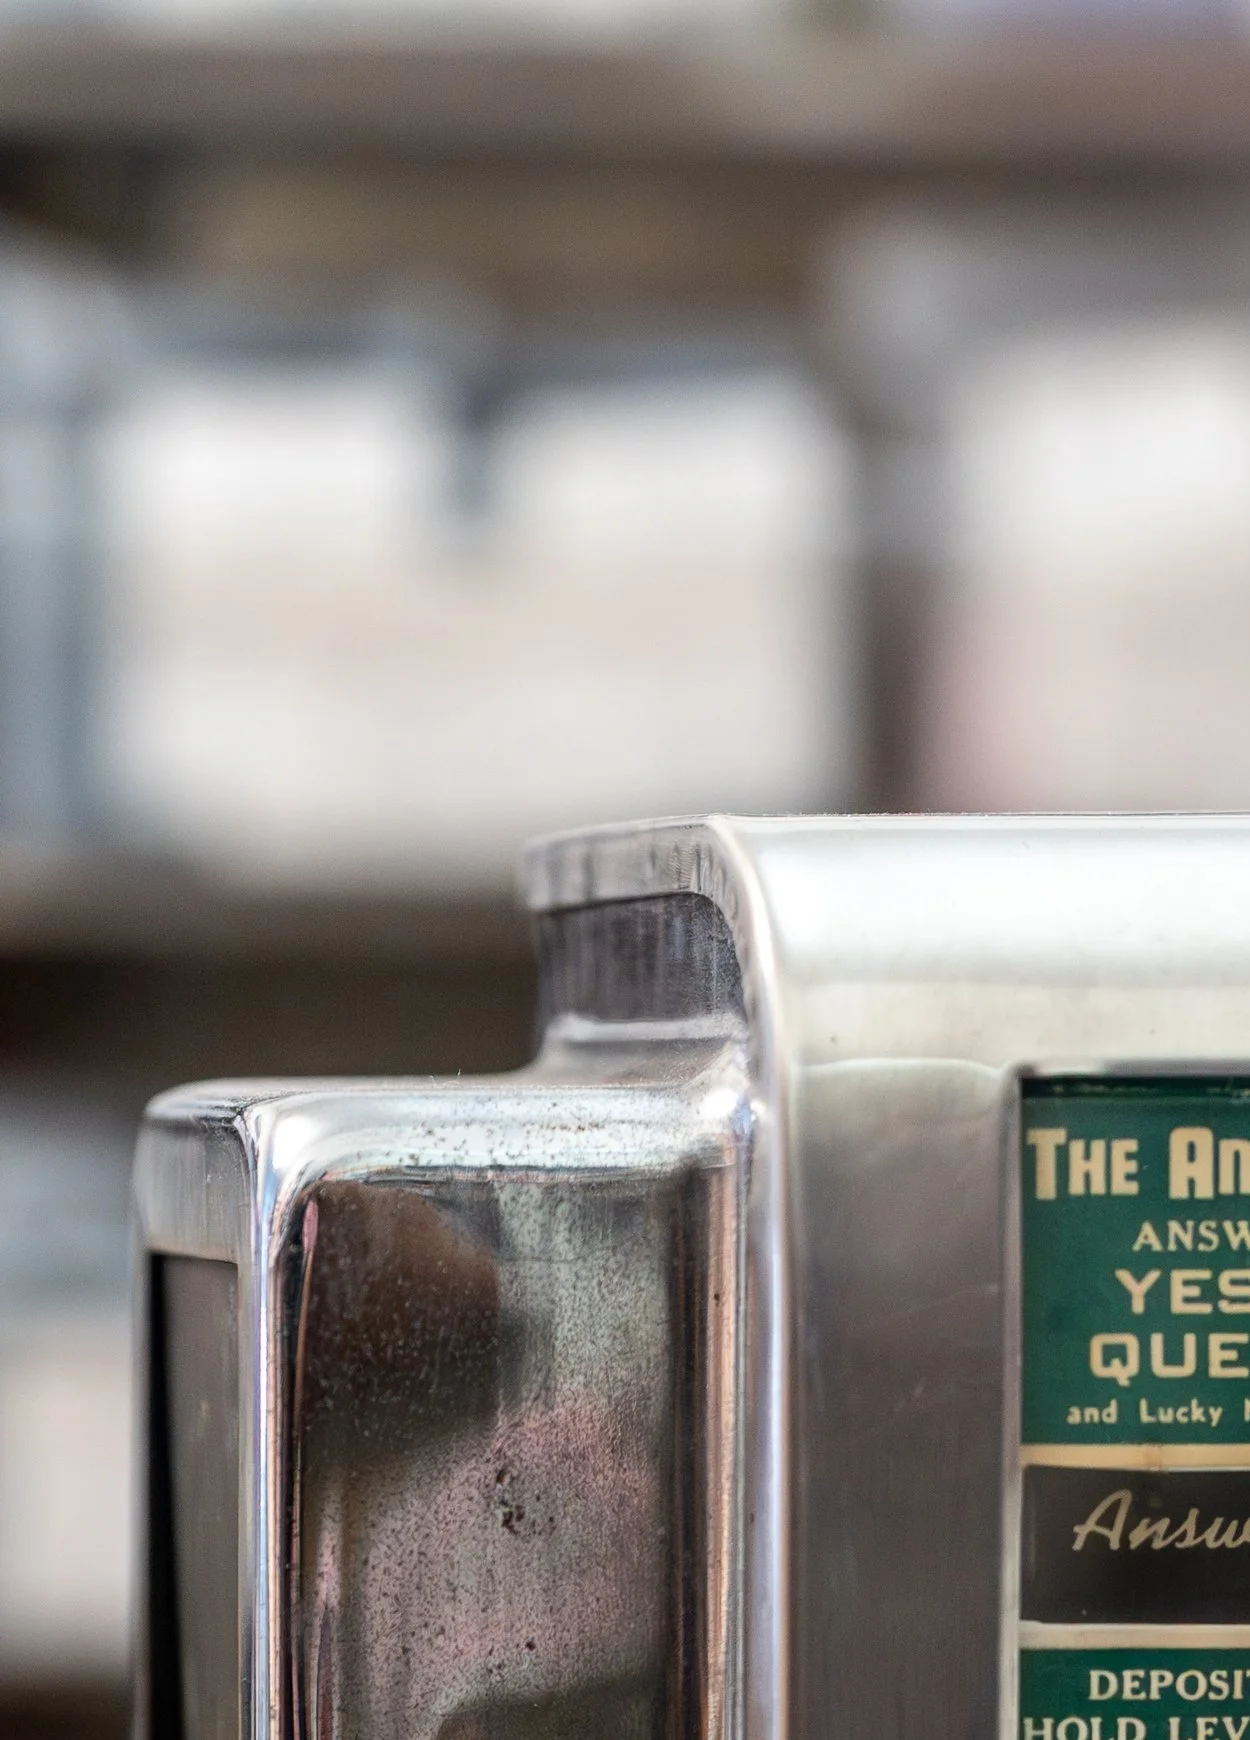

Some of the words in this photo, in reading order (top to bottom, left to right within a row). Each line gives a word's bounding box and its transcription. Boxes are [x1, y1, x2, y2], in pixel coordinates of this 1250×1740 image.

[1028, 1128, 1138, 1199] THE
[1068, 1400, 1117, 1424] and
[1140, 1399, 1222, 1426] Lucky
